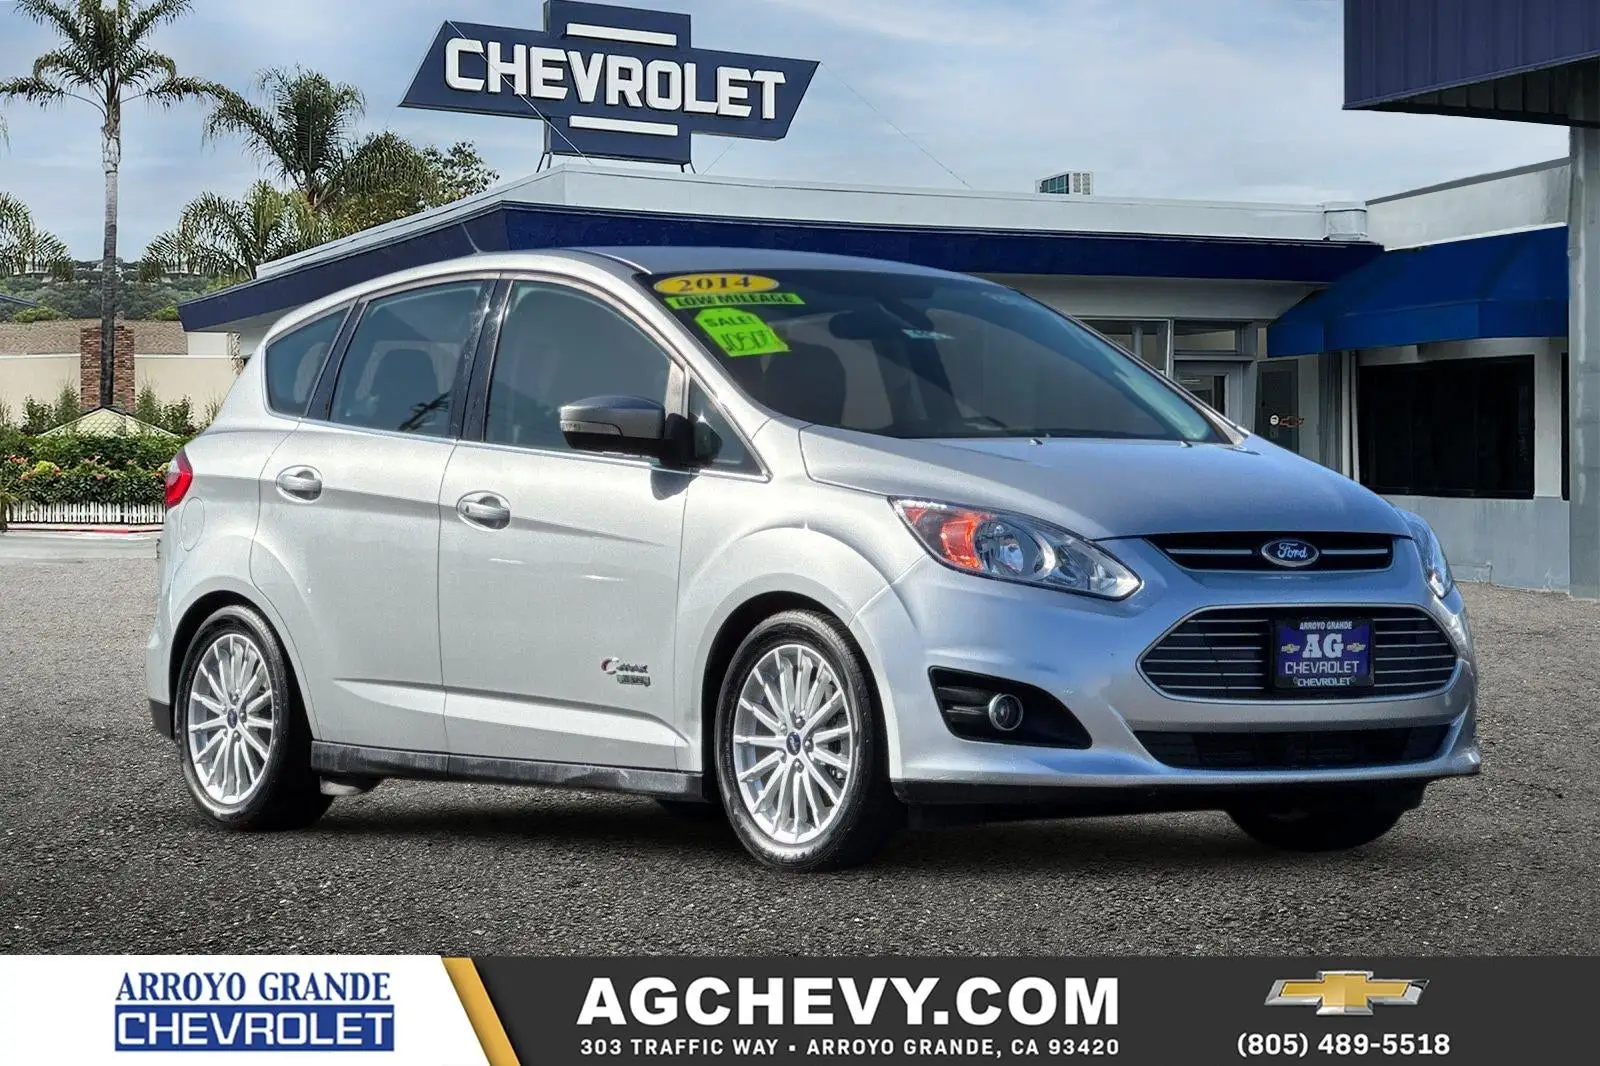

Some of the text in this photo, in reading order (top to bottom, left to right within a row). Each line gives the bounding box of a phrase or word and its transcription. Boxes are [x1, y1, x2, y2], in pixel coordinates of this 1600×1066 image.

[445, 37, 787, 119] CHEVROLET
[677, 276, 752, 292] 2014
[675, 293, 793, 305] LOW MILEAGE
[1277, 542, 1308, 559] Ford
[1300, 621, 1352, 630] ARROYO GRANDE
[1302, 633, 1344, 658] AG
[1285, 661, 1359, 674] CHEVROLET
[1297, 677, 1351, 687] CHEVROLET
